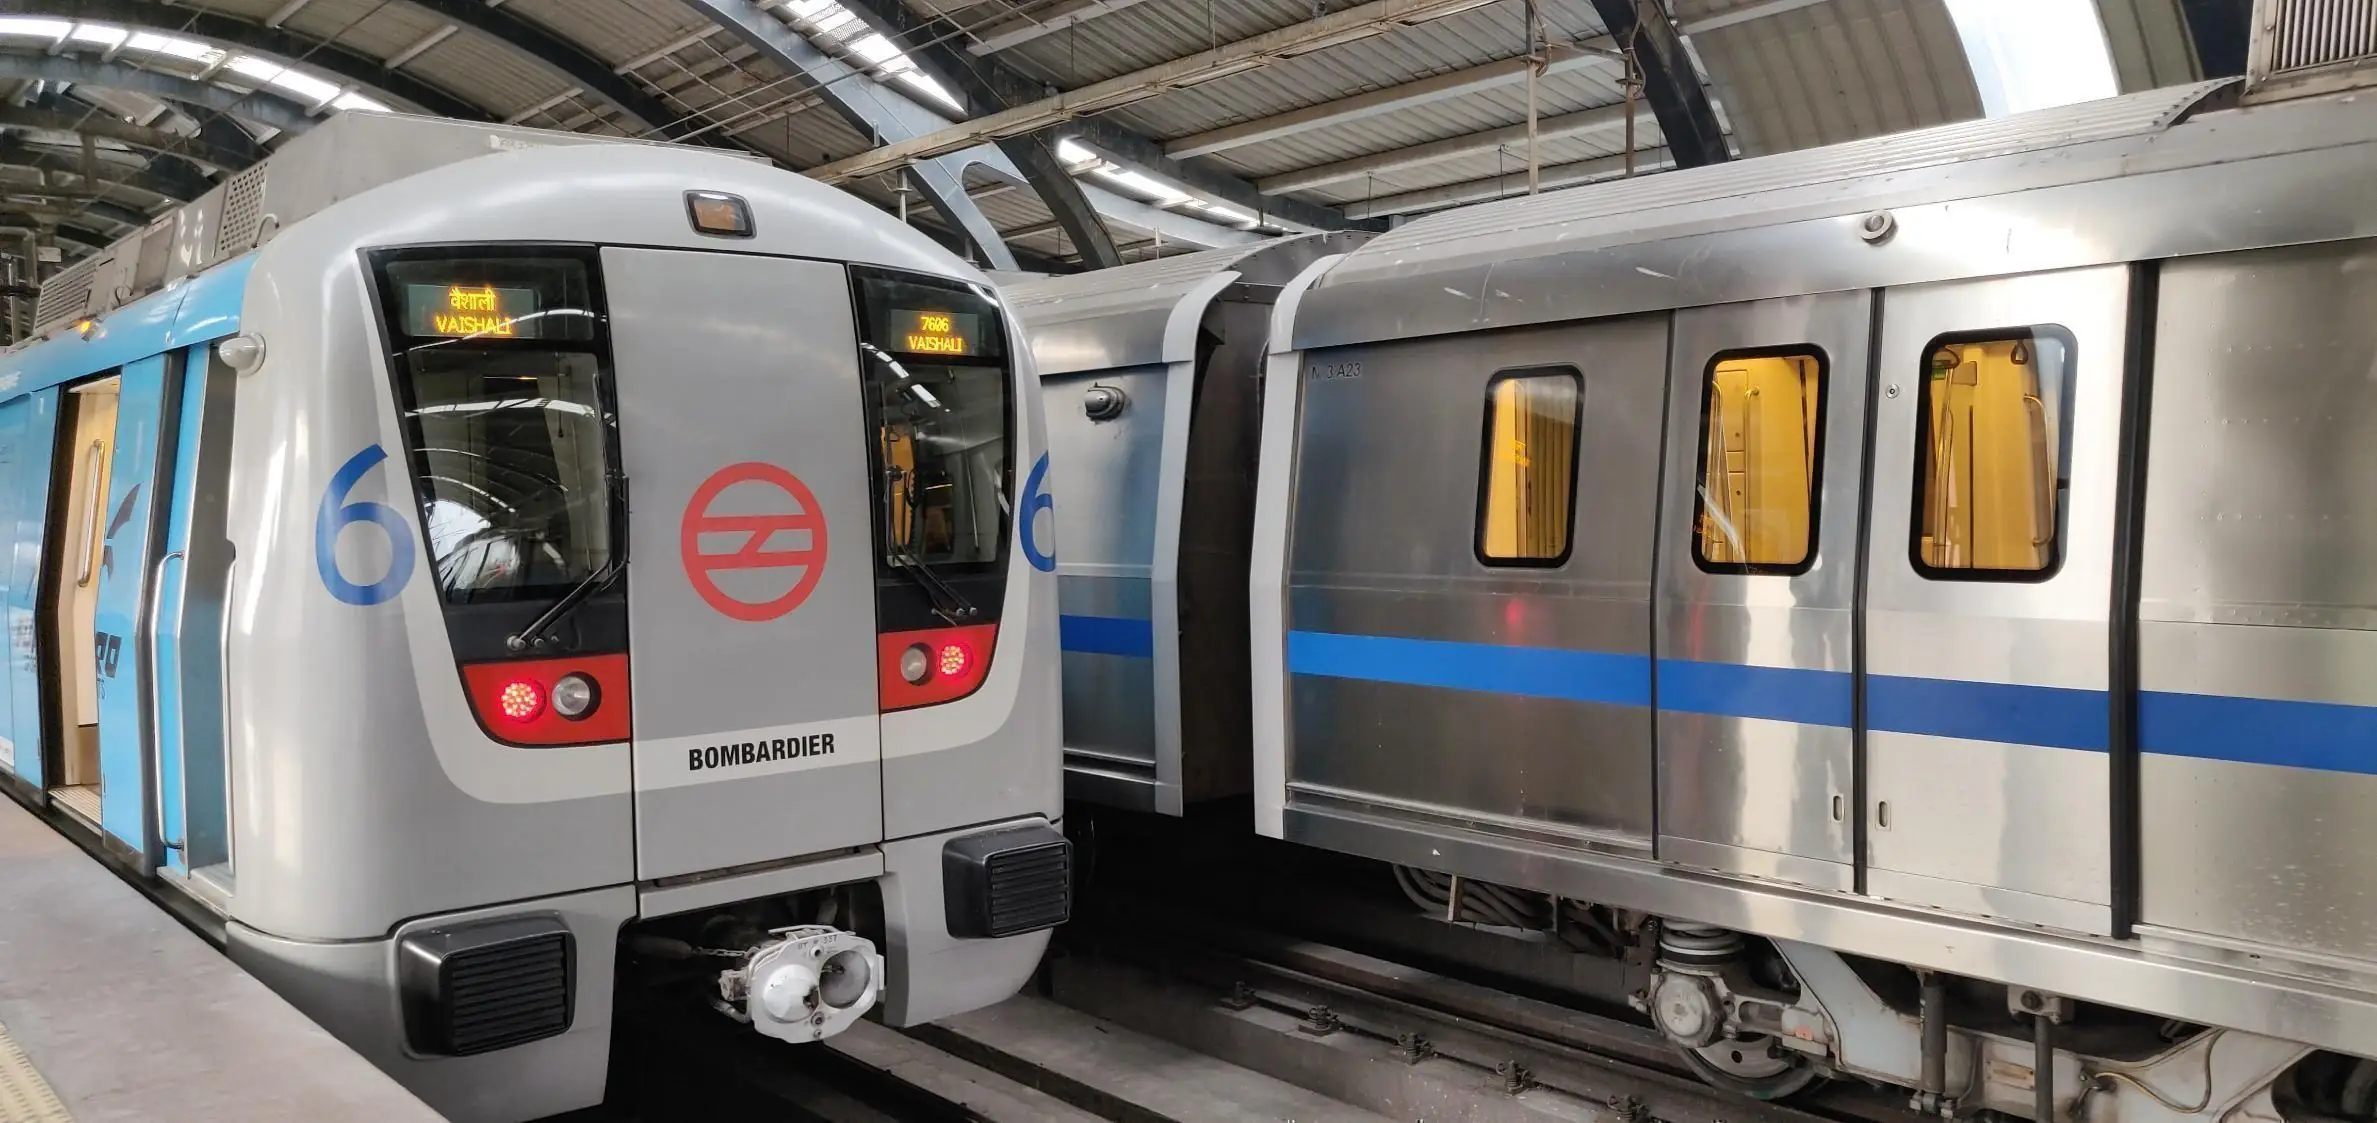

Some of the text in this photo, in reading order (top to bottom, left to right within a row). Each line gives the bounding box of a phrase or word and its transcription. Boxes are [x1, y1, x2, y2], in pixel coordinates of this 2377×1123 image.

[449, 285, 496, 311] वैशाली
[435, 315, 512, 335] VAISHALI
[921, 316, 949, 332] 7606
[908, 335, 963, 352] VAISHALI
[1019, 449, 1056, 572] 6
[315, 443, 416, 606] 6
[688, 733, 835, 771] BOMBARDIER
